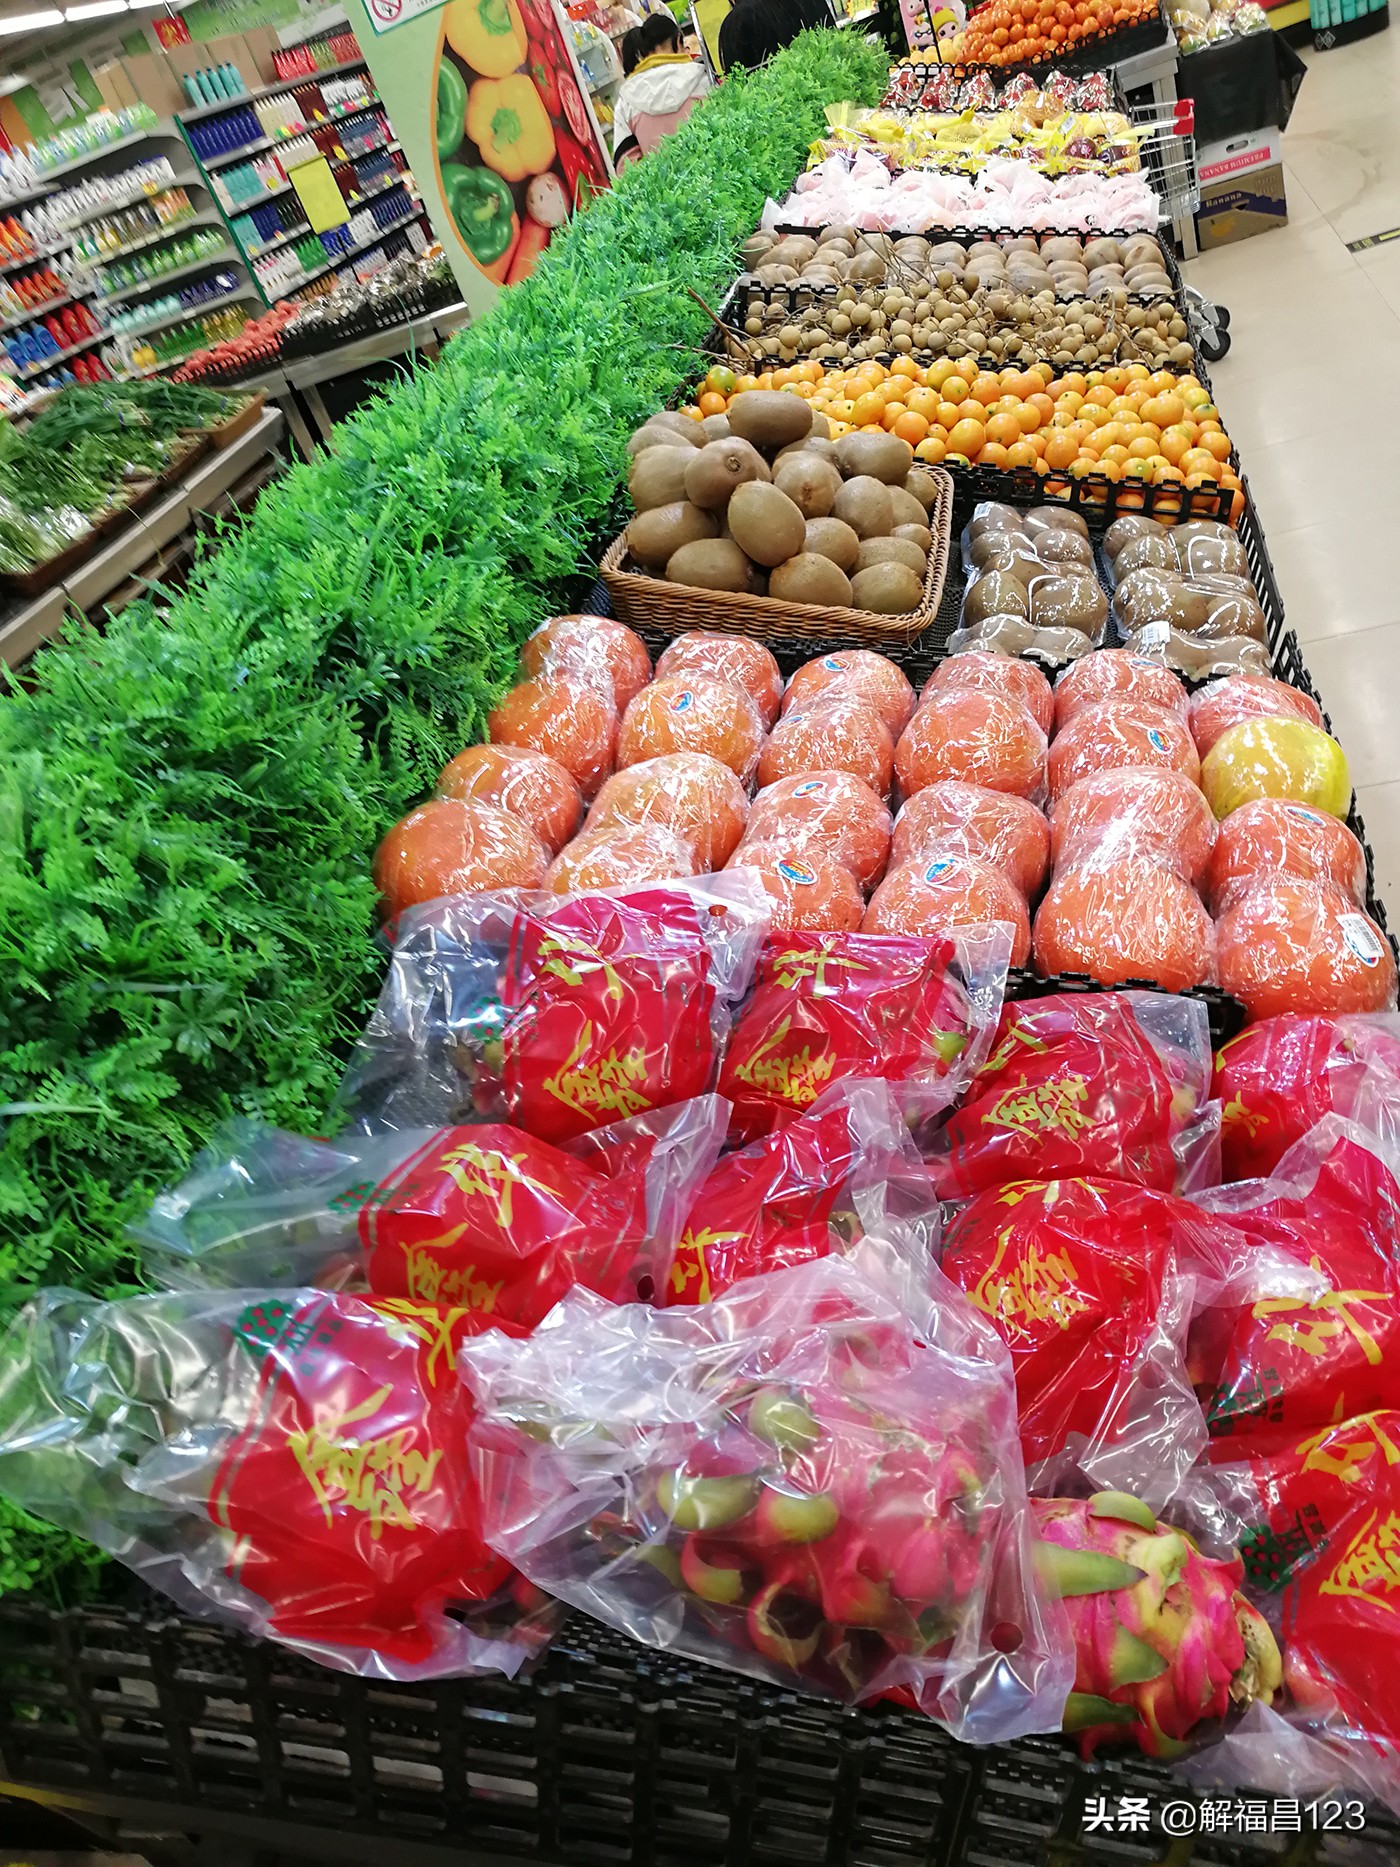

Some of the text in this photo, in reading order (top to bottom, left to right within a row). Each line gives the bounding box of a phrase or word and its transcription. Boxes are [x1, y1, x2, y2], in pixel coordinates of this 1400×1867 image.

[1199, 152, 1264, 178] PREMIUM BANANA
[1206, 193, 1242, 208] Banana
